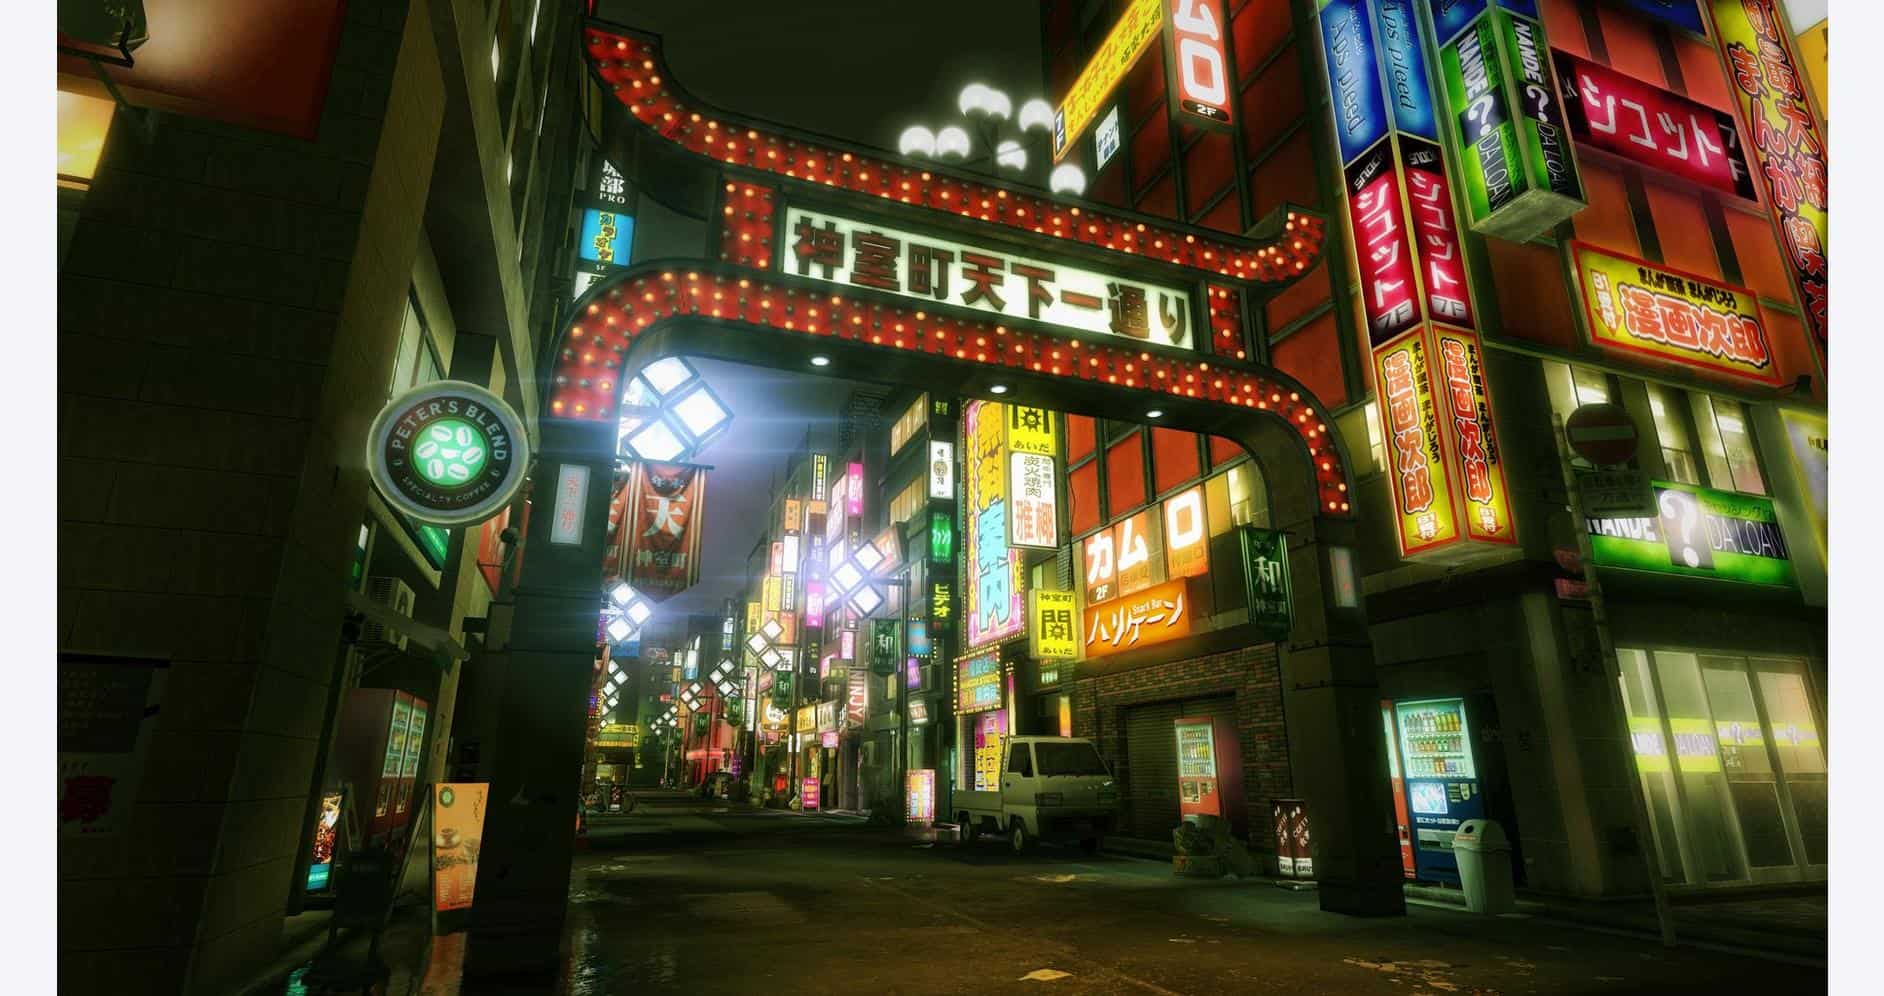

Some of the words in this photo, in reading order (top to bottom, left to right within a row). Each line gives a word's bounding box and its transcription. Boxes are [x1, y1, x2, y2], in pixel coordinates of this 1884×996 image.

[1456, 29, 1489, 101] NANDE
[1513, 18, 1542, 84] NANDE
[1055, 113, 1065, 151] 1F
[1197, 104, 1217, 116] 2F
[1582, 74, 1721, 167] シコット
[600, 192, 626, 204] PRO
[1357, 181, 1404, 309] シコット
[1411, 172, 1458, 290] シコット
[793, 215, 1190, 345] 神室町天下一通り
[1431, 295, 1468, 320] 7F
[1376, 298, 1415, 329] 7F
[1618, 282, 1769, 369] 漫画次郎
[392, 400, 459, 450] PETER'S
[465, 404, 507, 461] BLEND
[1013, 439, 1050, 453] あいだ
[1383, 349, 1434, 514] 漫画次郎
[1441, 337, 1493, 505] 漫画次郎
[641, 494, 687, 539] 天
[1087, 489, 1203, 585] カムロ
[932, 583, 950, 618] ビデオ
[1096, 585, 1108, 600] 2F
[1253, 555, 1283, 594] 和
[1086, 591, 1184, 646] ハリケーン
